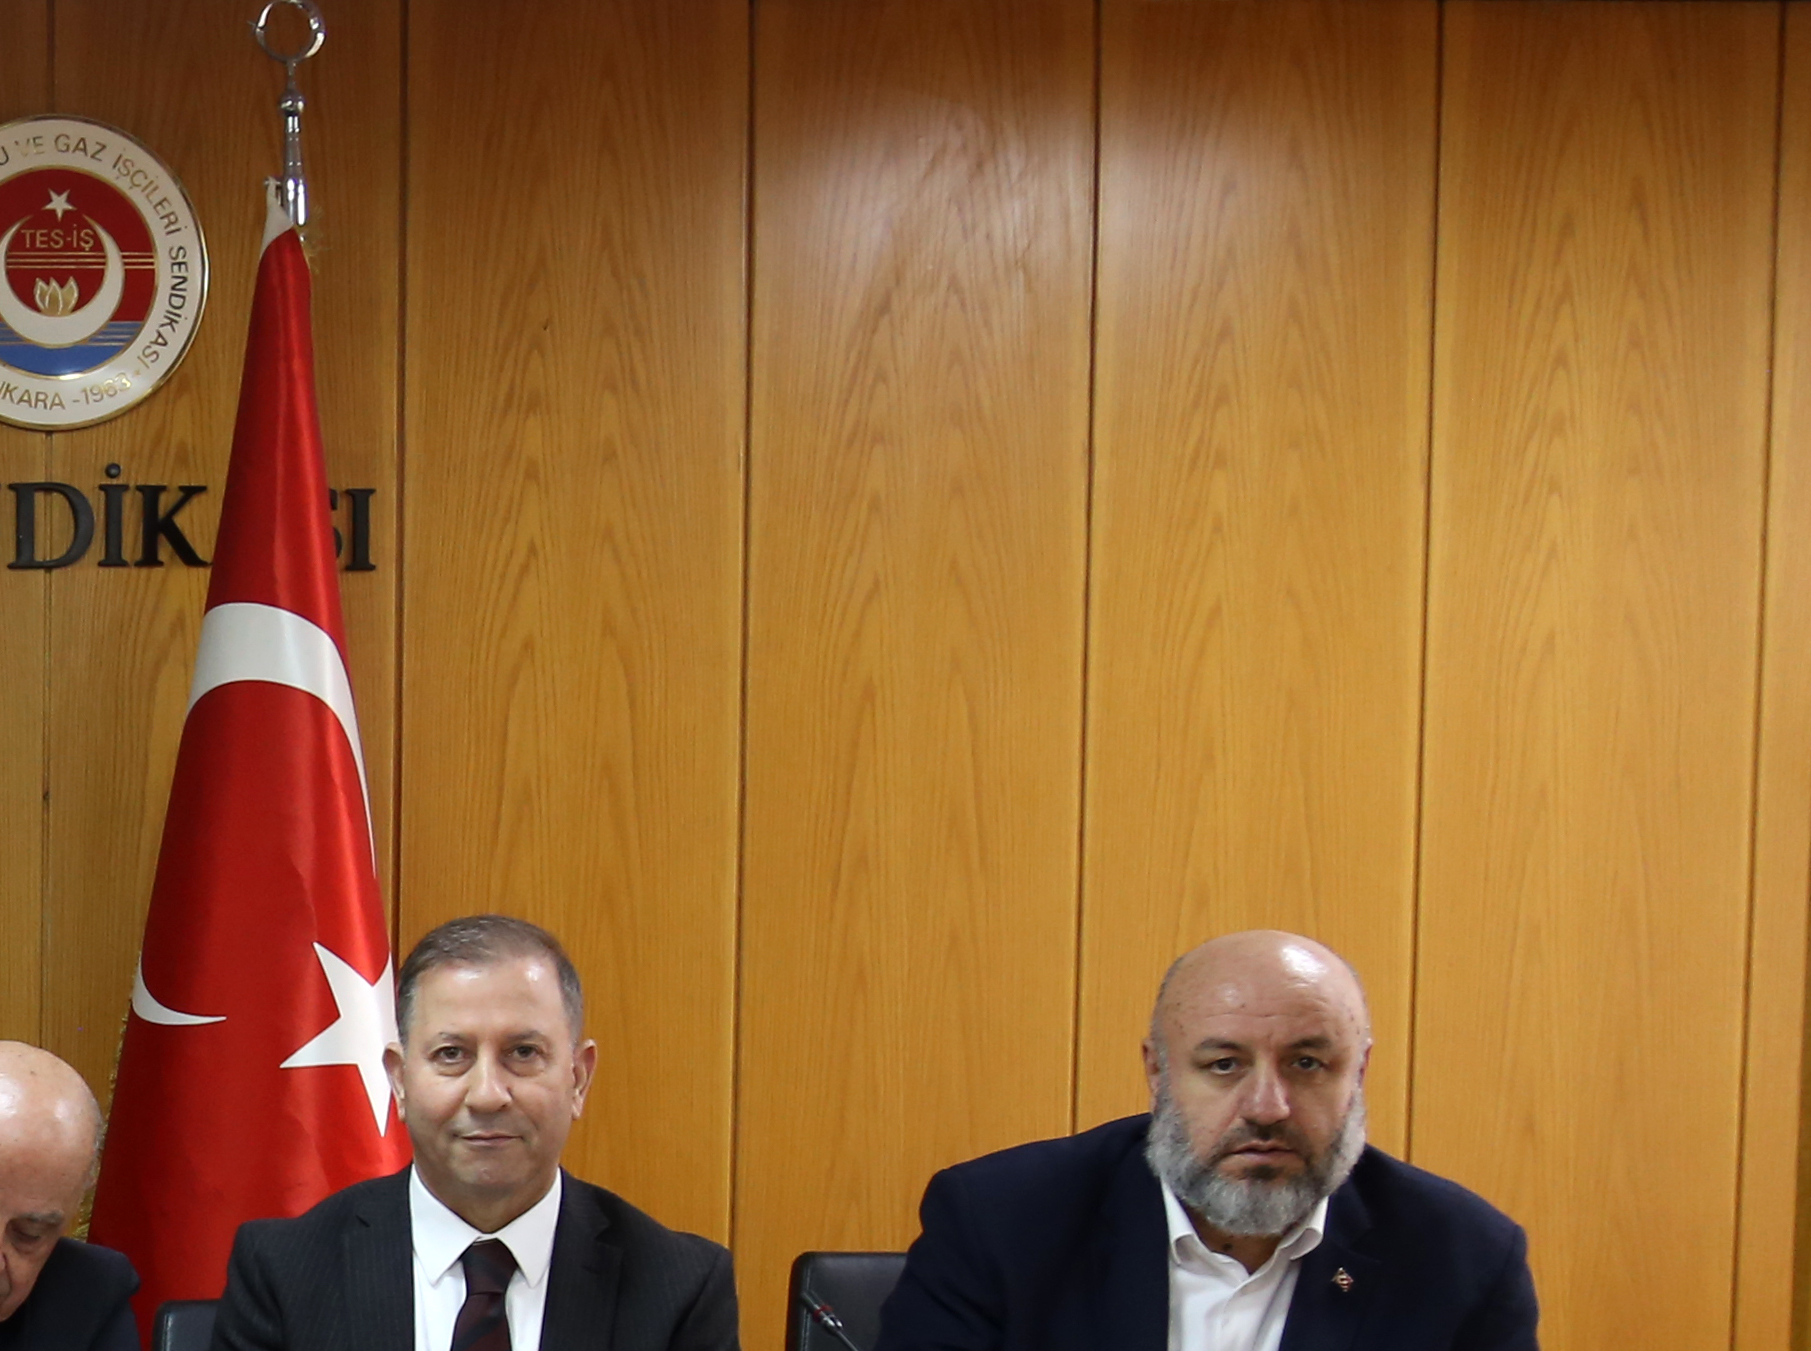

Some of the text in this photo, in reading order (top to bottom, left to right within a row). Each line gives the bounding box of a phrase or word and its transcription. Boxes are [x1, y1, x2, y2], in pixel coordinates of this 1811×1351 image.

[53, 133, 108, 162] GAZ
[111, 147, 189, 237] İŞÇİLERİ
[20, 223, 96, 251] TES-İŞ
[135, 245, 190, 370] SENDİKASI
